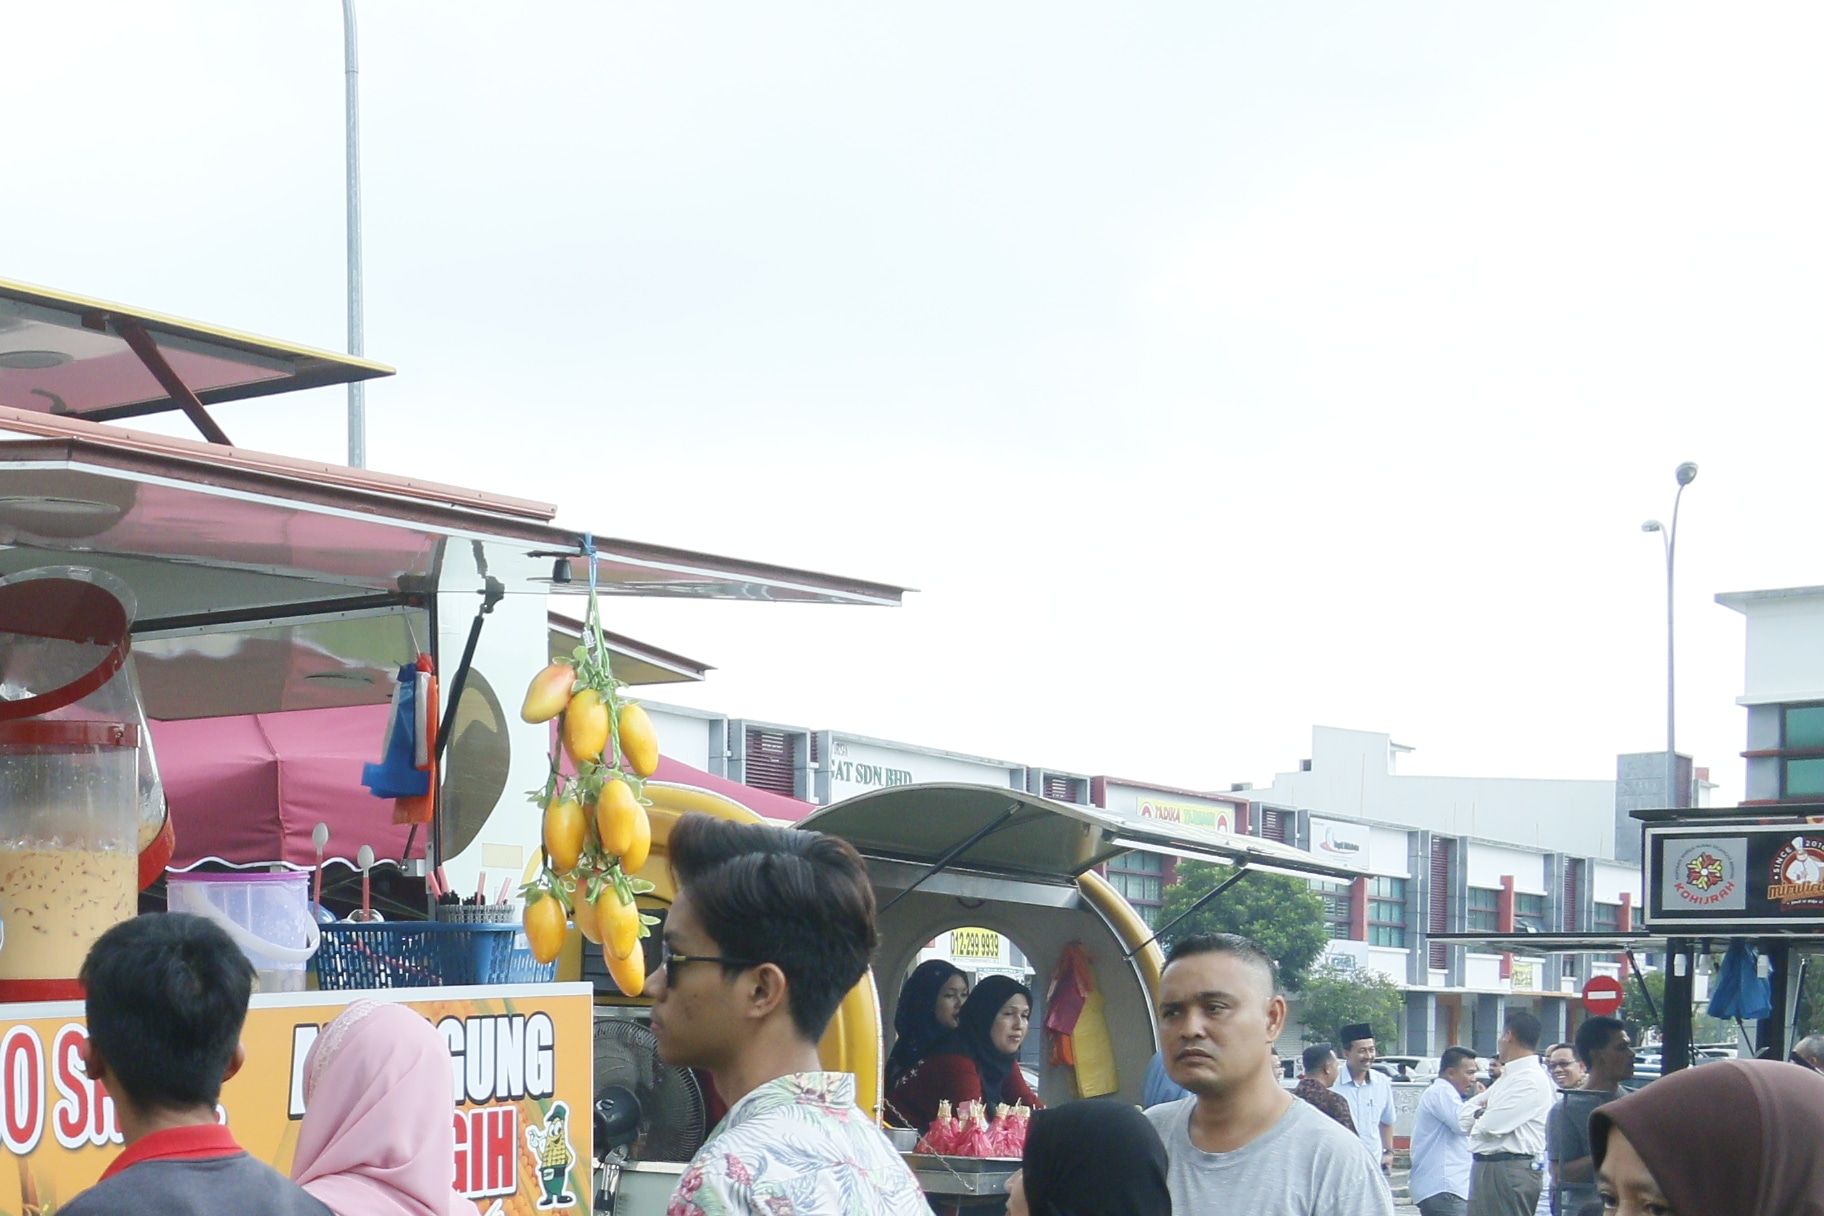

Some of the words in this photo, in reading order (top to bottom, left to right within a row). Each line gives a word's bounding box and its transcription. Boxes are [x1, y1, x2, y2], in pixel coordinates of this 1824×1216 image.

[856, 763, 883, 786] SDN
[885, 768, 913, 787] BHD
[1773, 846, 1792, 873] SINCE
[1805, 840, 1824, 849] 201
[950, 931, 979, 955] 012-299
